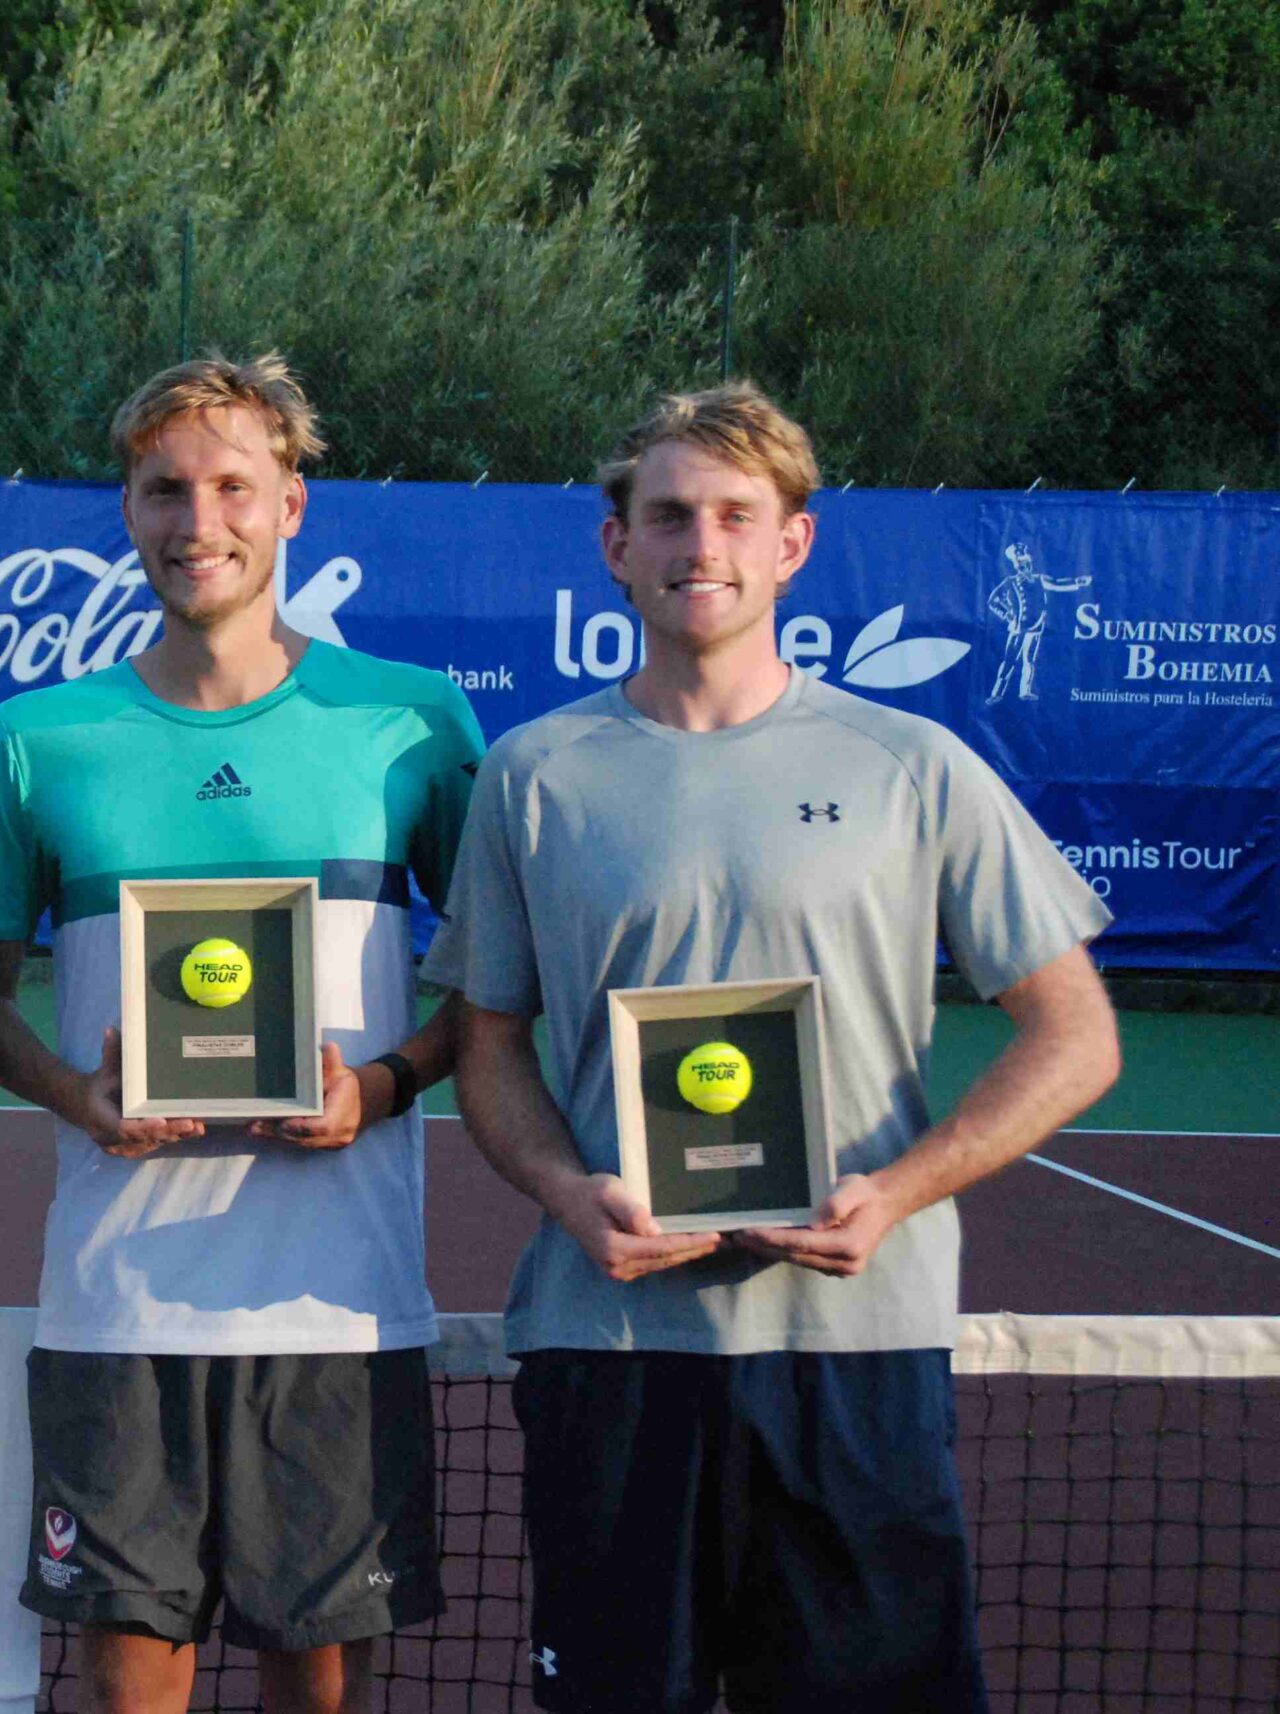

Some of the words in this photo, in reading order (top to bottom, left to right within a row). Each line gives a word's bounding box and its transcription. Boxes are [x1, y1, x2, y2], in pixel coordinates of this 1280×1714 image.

[1124, 644, 1273, 683] BOHEMIA
[1070, 687, 1150, 704] Suministros
[1153, 693, 1183, 707] para
[1188, 690, 1200, 705] la
[196, 784, 252, 801] adidas
[194, 963, 243, 971] HEAD
[199, 971, 238, 983] TOUR
[698, 1069, 736, 1082] TOUR
